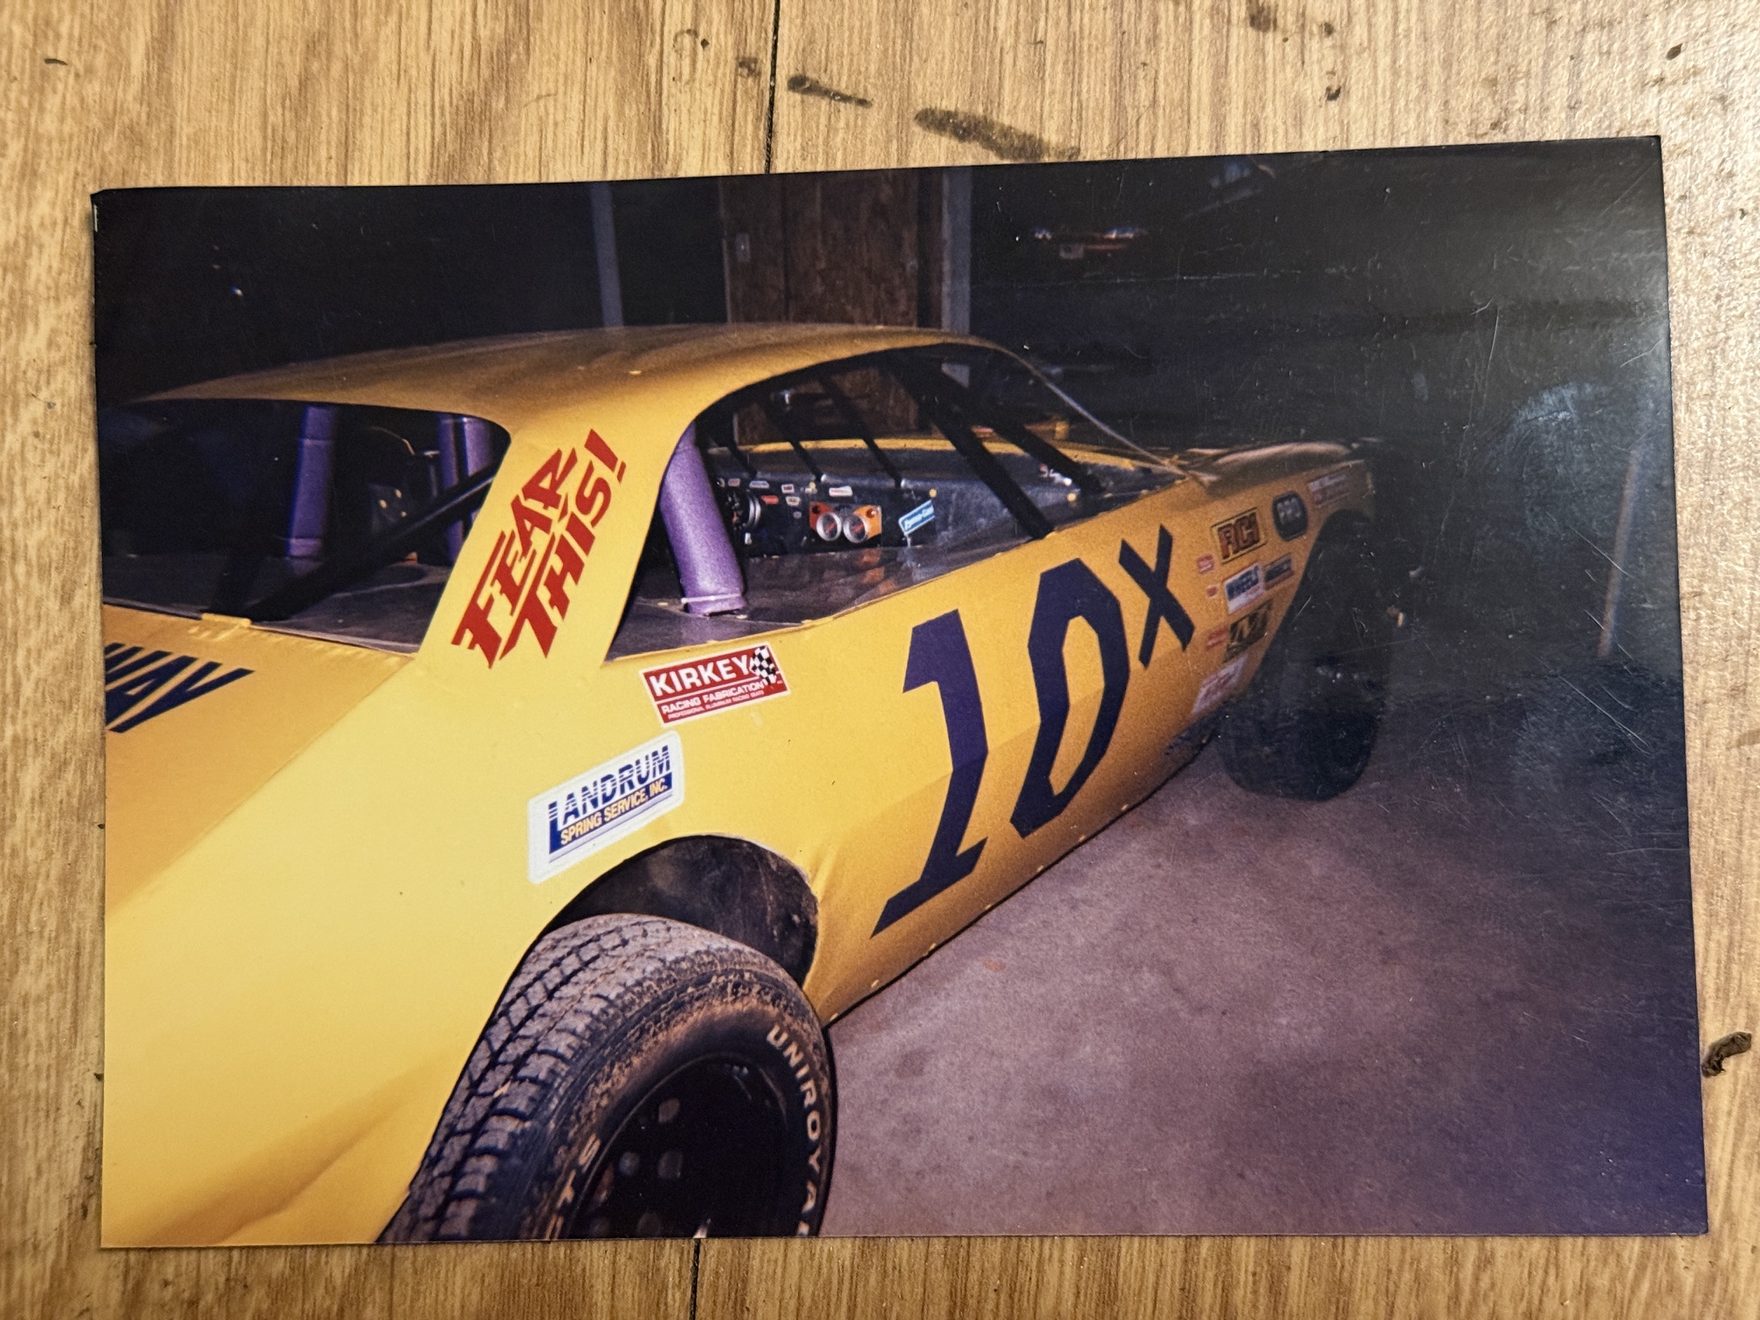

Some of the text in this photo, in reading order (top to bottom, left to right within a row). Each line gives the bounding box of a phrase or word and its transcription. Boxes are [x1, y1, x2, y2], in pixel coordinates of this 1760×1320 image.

[451, 448, 578, 669] FEAR
[499, 429, 627, 658] THIS!
[649, 654, 752, 697] KIRKEY
[661, 680, 766, 714] RACING FABRICATION
[548, 745, 672, 854] LANDRUM
[560, 809, 602, 846] SPRING
[649, 777, 668, 801] INC.
